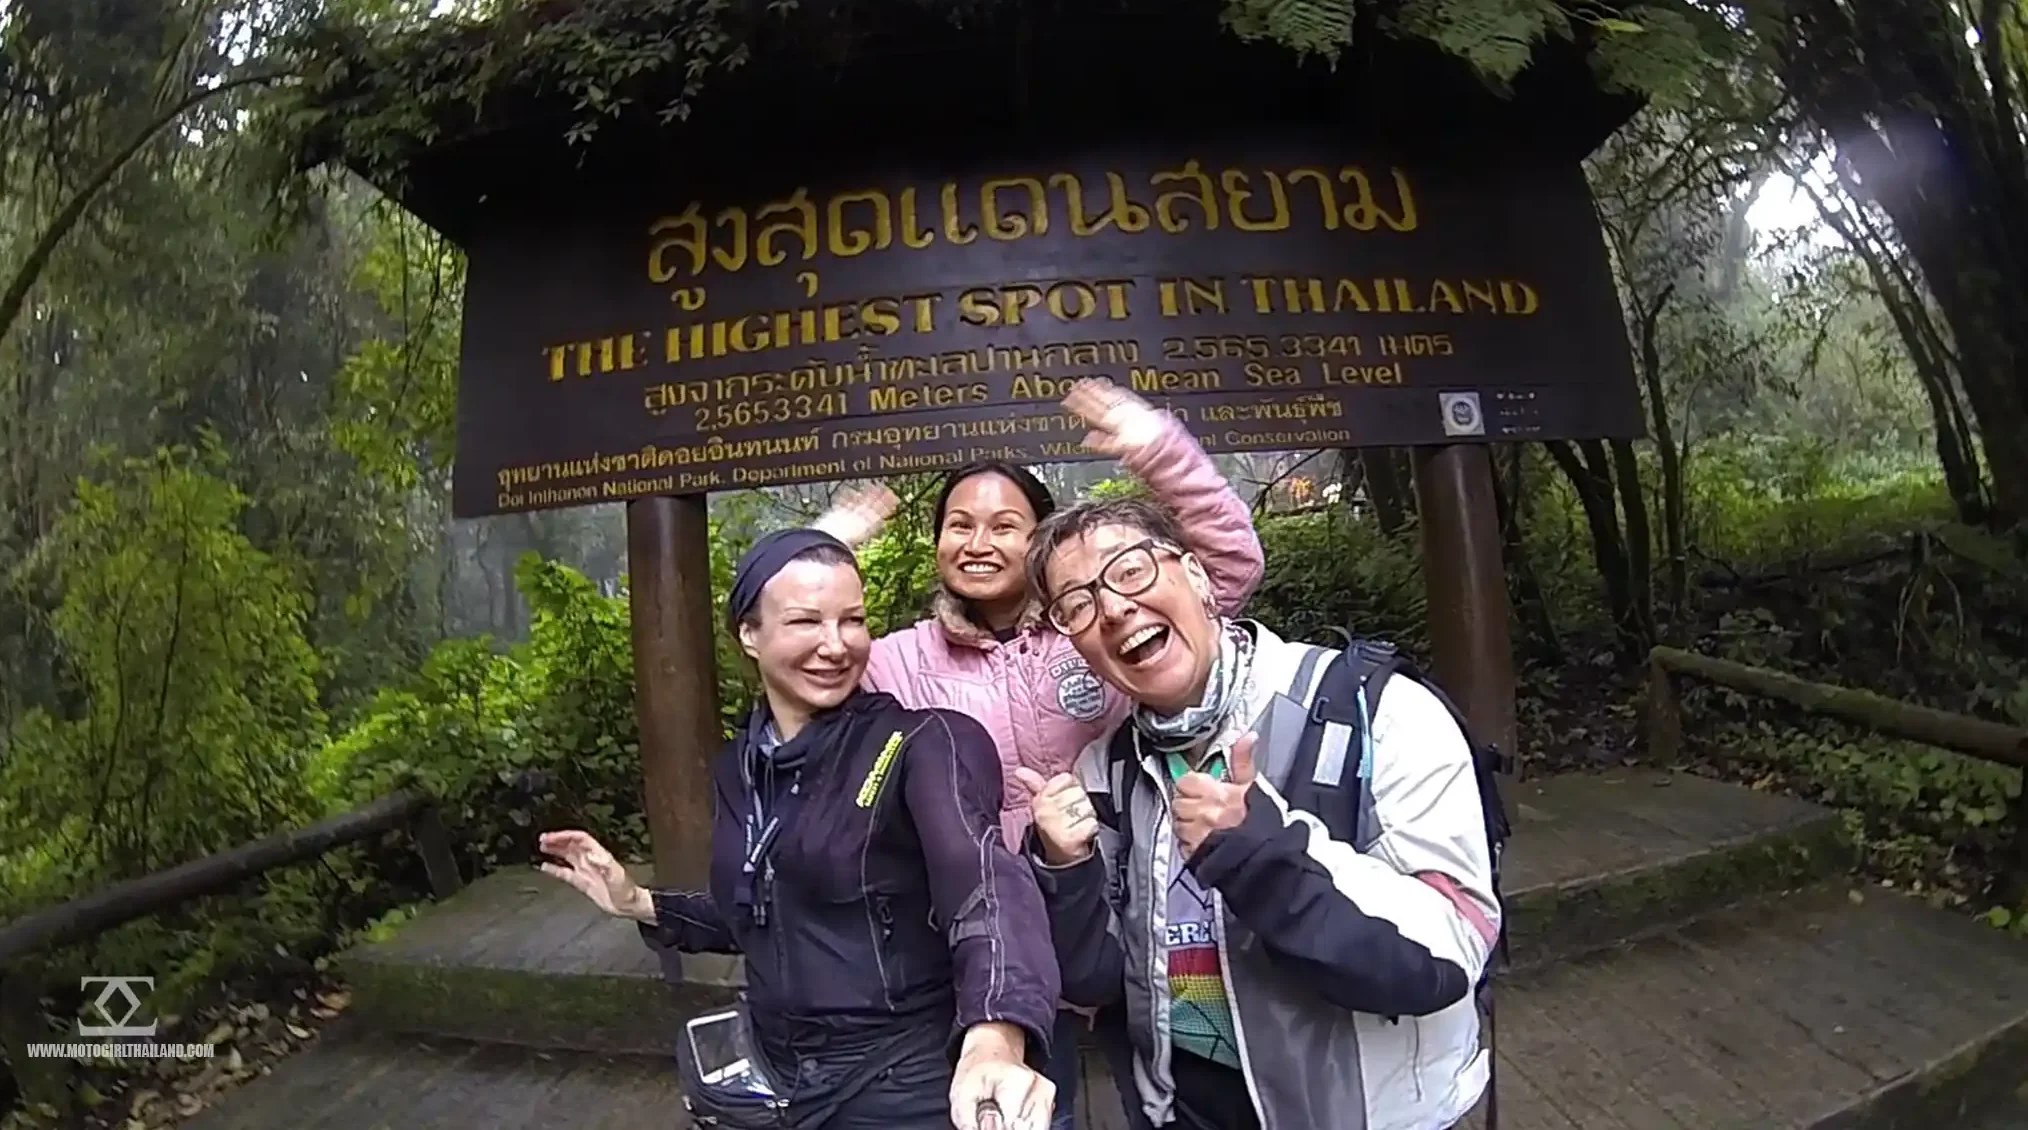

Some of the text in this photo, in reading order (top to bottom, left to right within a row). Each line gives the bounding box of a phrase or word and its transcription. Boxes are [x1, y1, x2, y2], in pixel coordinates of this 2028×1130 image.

[648, 160, 1418, 311] สูงสุดแดนสยาม
[543, 278, 1541, 382] THE HIGHEST SPOT IN THAILAND
[1378, 334, 1454, 357] เมตร
[869, 380, 989, 412] Meters
[1012, 374, 1078, 400] Abo
[1130, 367, 1221, 392] Mean
[1244, 362, 1301, 387] Sea
[1322, 361, 1403, 385] Level
[498, 491, 524, 508] Doi
[528, 484, 598, 505] Inthanon
[602, 474, 673, 496] National
[732, 459, 846, 484] Department
[853, 455, 872, 473] of
[880, 449, 963, 469] National
[1225, 429, 1351, 446] Conservation
